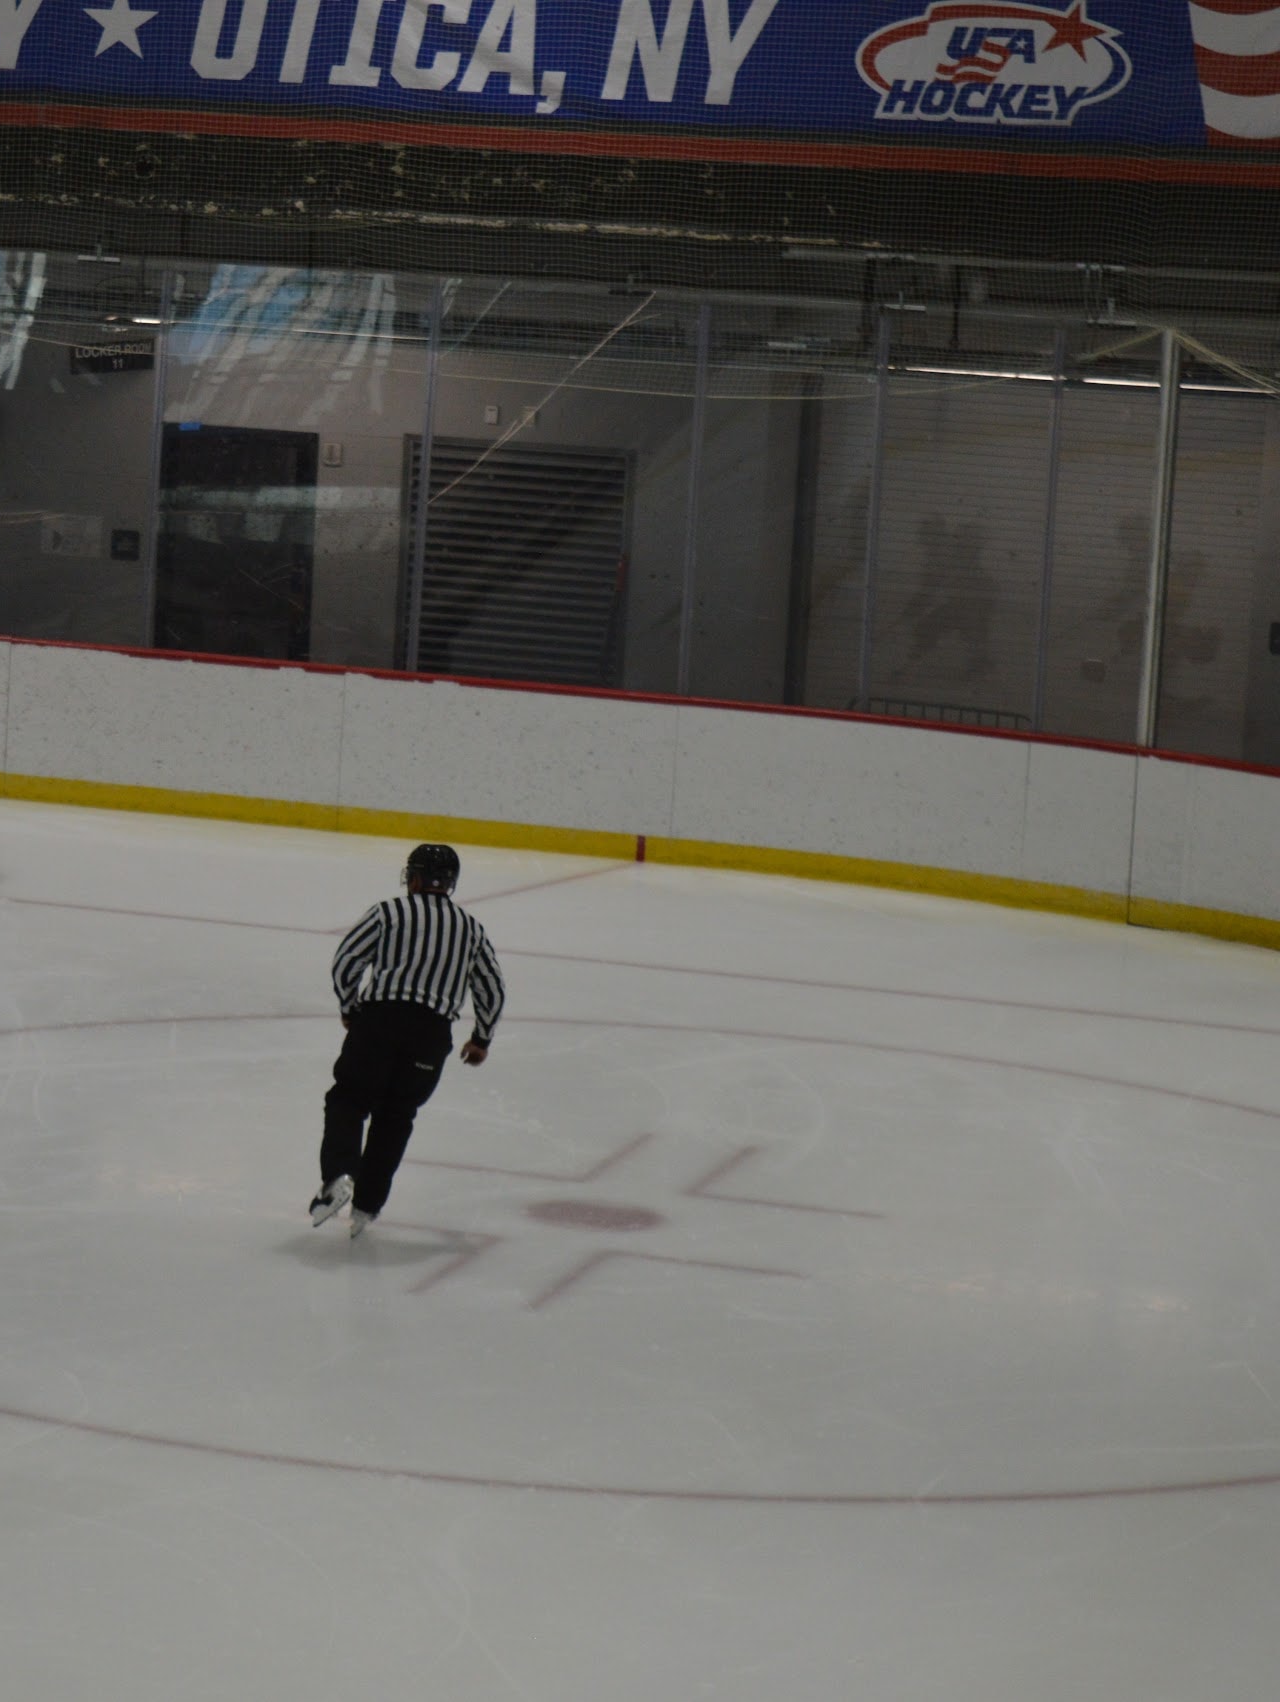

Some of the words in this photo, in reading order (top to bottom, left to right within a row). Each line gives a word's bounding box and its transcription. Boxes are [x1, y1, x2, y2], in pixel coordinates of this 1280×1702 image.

[189, 0, 567, 113] UTICA,
[600, 0, 780, 105] NY
[946, 25, 1036, 64] USA
[882, 79, 1089, 120] HOCKEY
[75, 344, 121, 359] LOCKER
